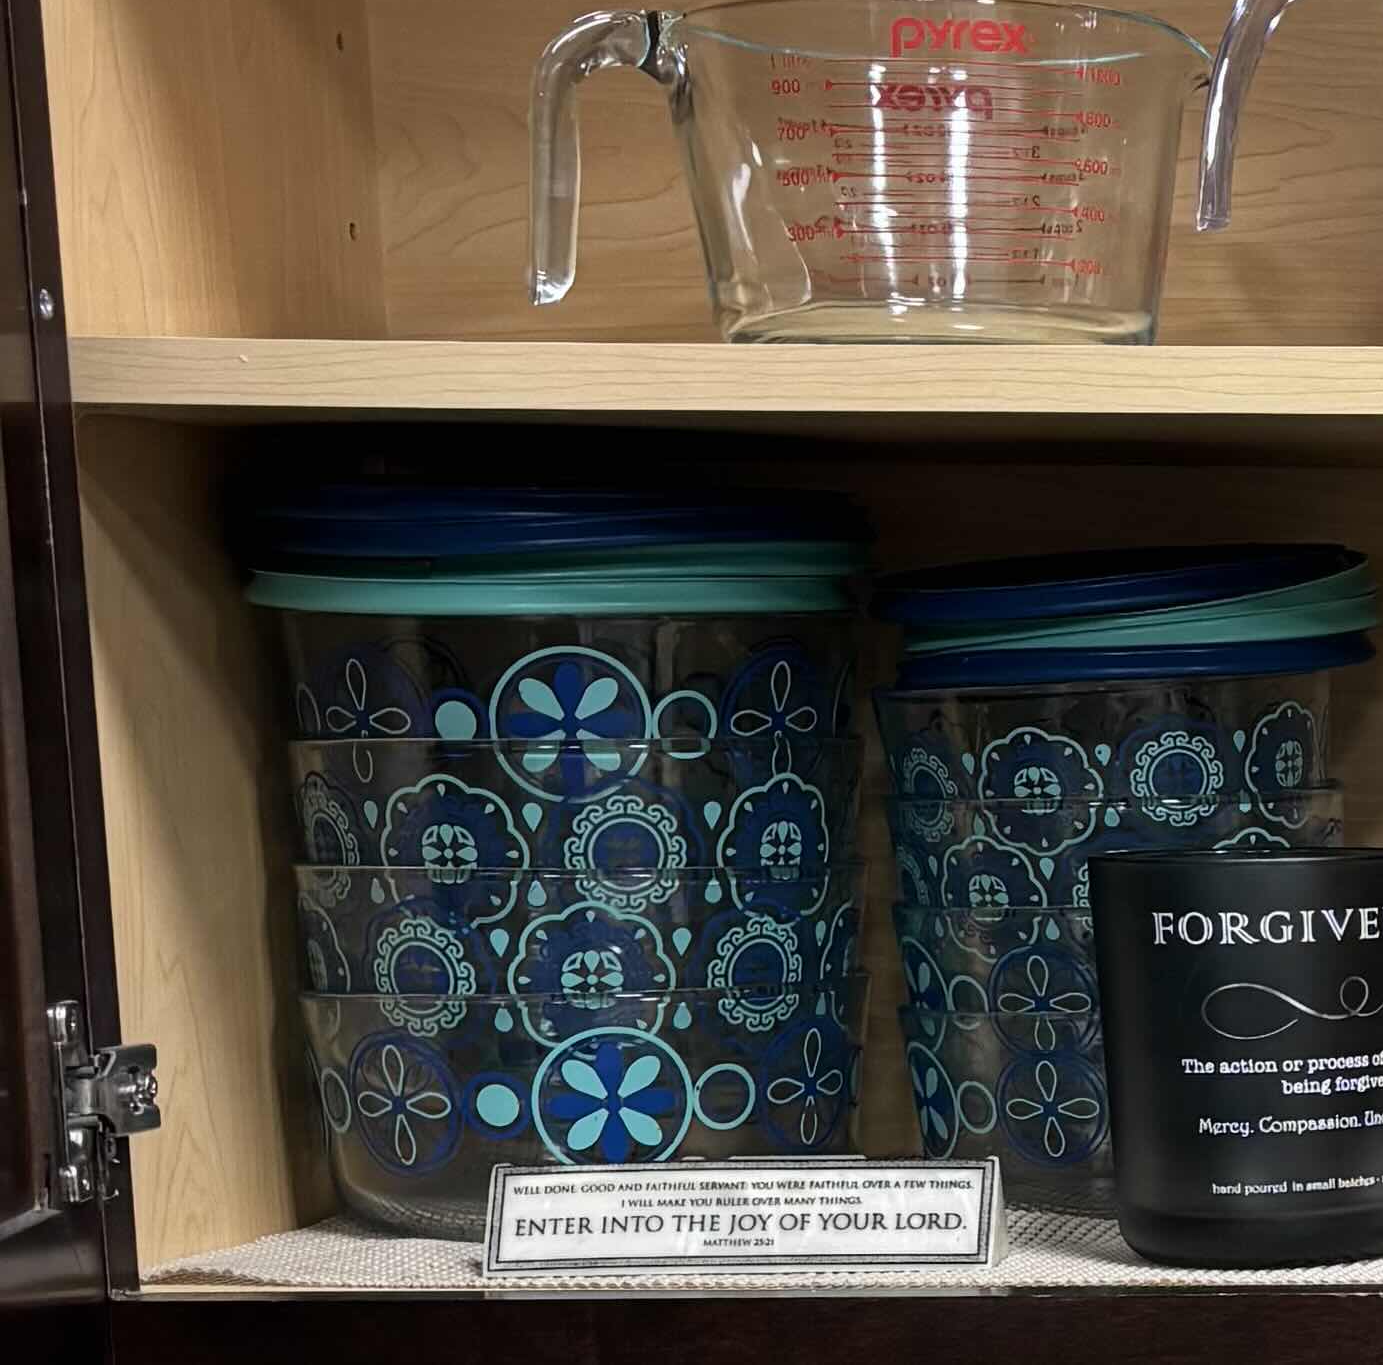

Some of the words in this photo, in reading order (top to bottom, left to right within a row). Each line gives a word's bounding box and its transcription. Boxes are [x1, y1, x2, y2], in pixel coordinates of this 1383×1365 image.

[890, 17, 1029, 58] pyrex
[771, 78, 800, 94] 900
[788, 225, 815, 242] 300
[1182, 1058, 1215, 1074] The
[1219, 1058, 1278, 1074] action
[1282, 1058, 1304, 1072] or
[1308, 1054, 1369, 1074] process
[1281, 1079, 1332, 1095] being
[1199, 1118, 1254, 1137] Mercy.
[1259, 1115, 1362, 1134] Compassion.
[514, 1185, 541, 1195] WELL
[581, 1183, 615, 1194] GOOD
[618, 1183, 642, 1192] AND
[645, 1182, 696, 1192] FAITHFUL
[751, 1182, 774, 1190] YOU
[777, 1181, 806, 1190] WERE
[809, 1181, 859, 1190] FAITHFUL
[863, 1180, 891, 1189] OVER
[893, 1181, 900, 1189] A
[904, 1180, 926, 1189] FEW
[1212, 1183, 1241, 1195] hand
[1244, 1181, 1288, 1196] poured
[1292, 1182, 1304, 1192] in
[1305, 1178, 1336, 1192] small
[1338, 1175, 1375, 1188] batches
[628, 1199, 653, 1208] WILL
[656, 1198, 687, 1207] MAKE
[690, 1198, 712, 1207] YOU
[715, 1197, 750, 1207] RULER
[752, 1197, 781, 1206] OVER
[784, 1197, 815, 1206] MANY
[515, 1216, 593, 1237] ENTER
[602, 1215, 664, 1234] INTO
[672, 1214, 721, 1233] THE
[729, 1213, 772, 1234] JOY
[779, 1213, 811, 1232] OF
[819, 1213, 888, 1231] YOUR
[896, 1212, 968, 1231] LORD.
[703, 1238, 751, 1247] MATTHEW
